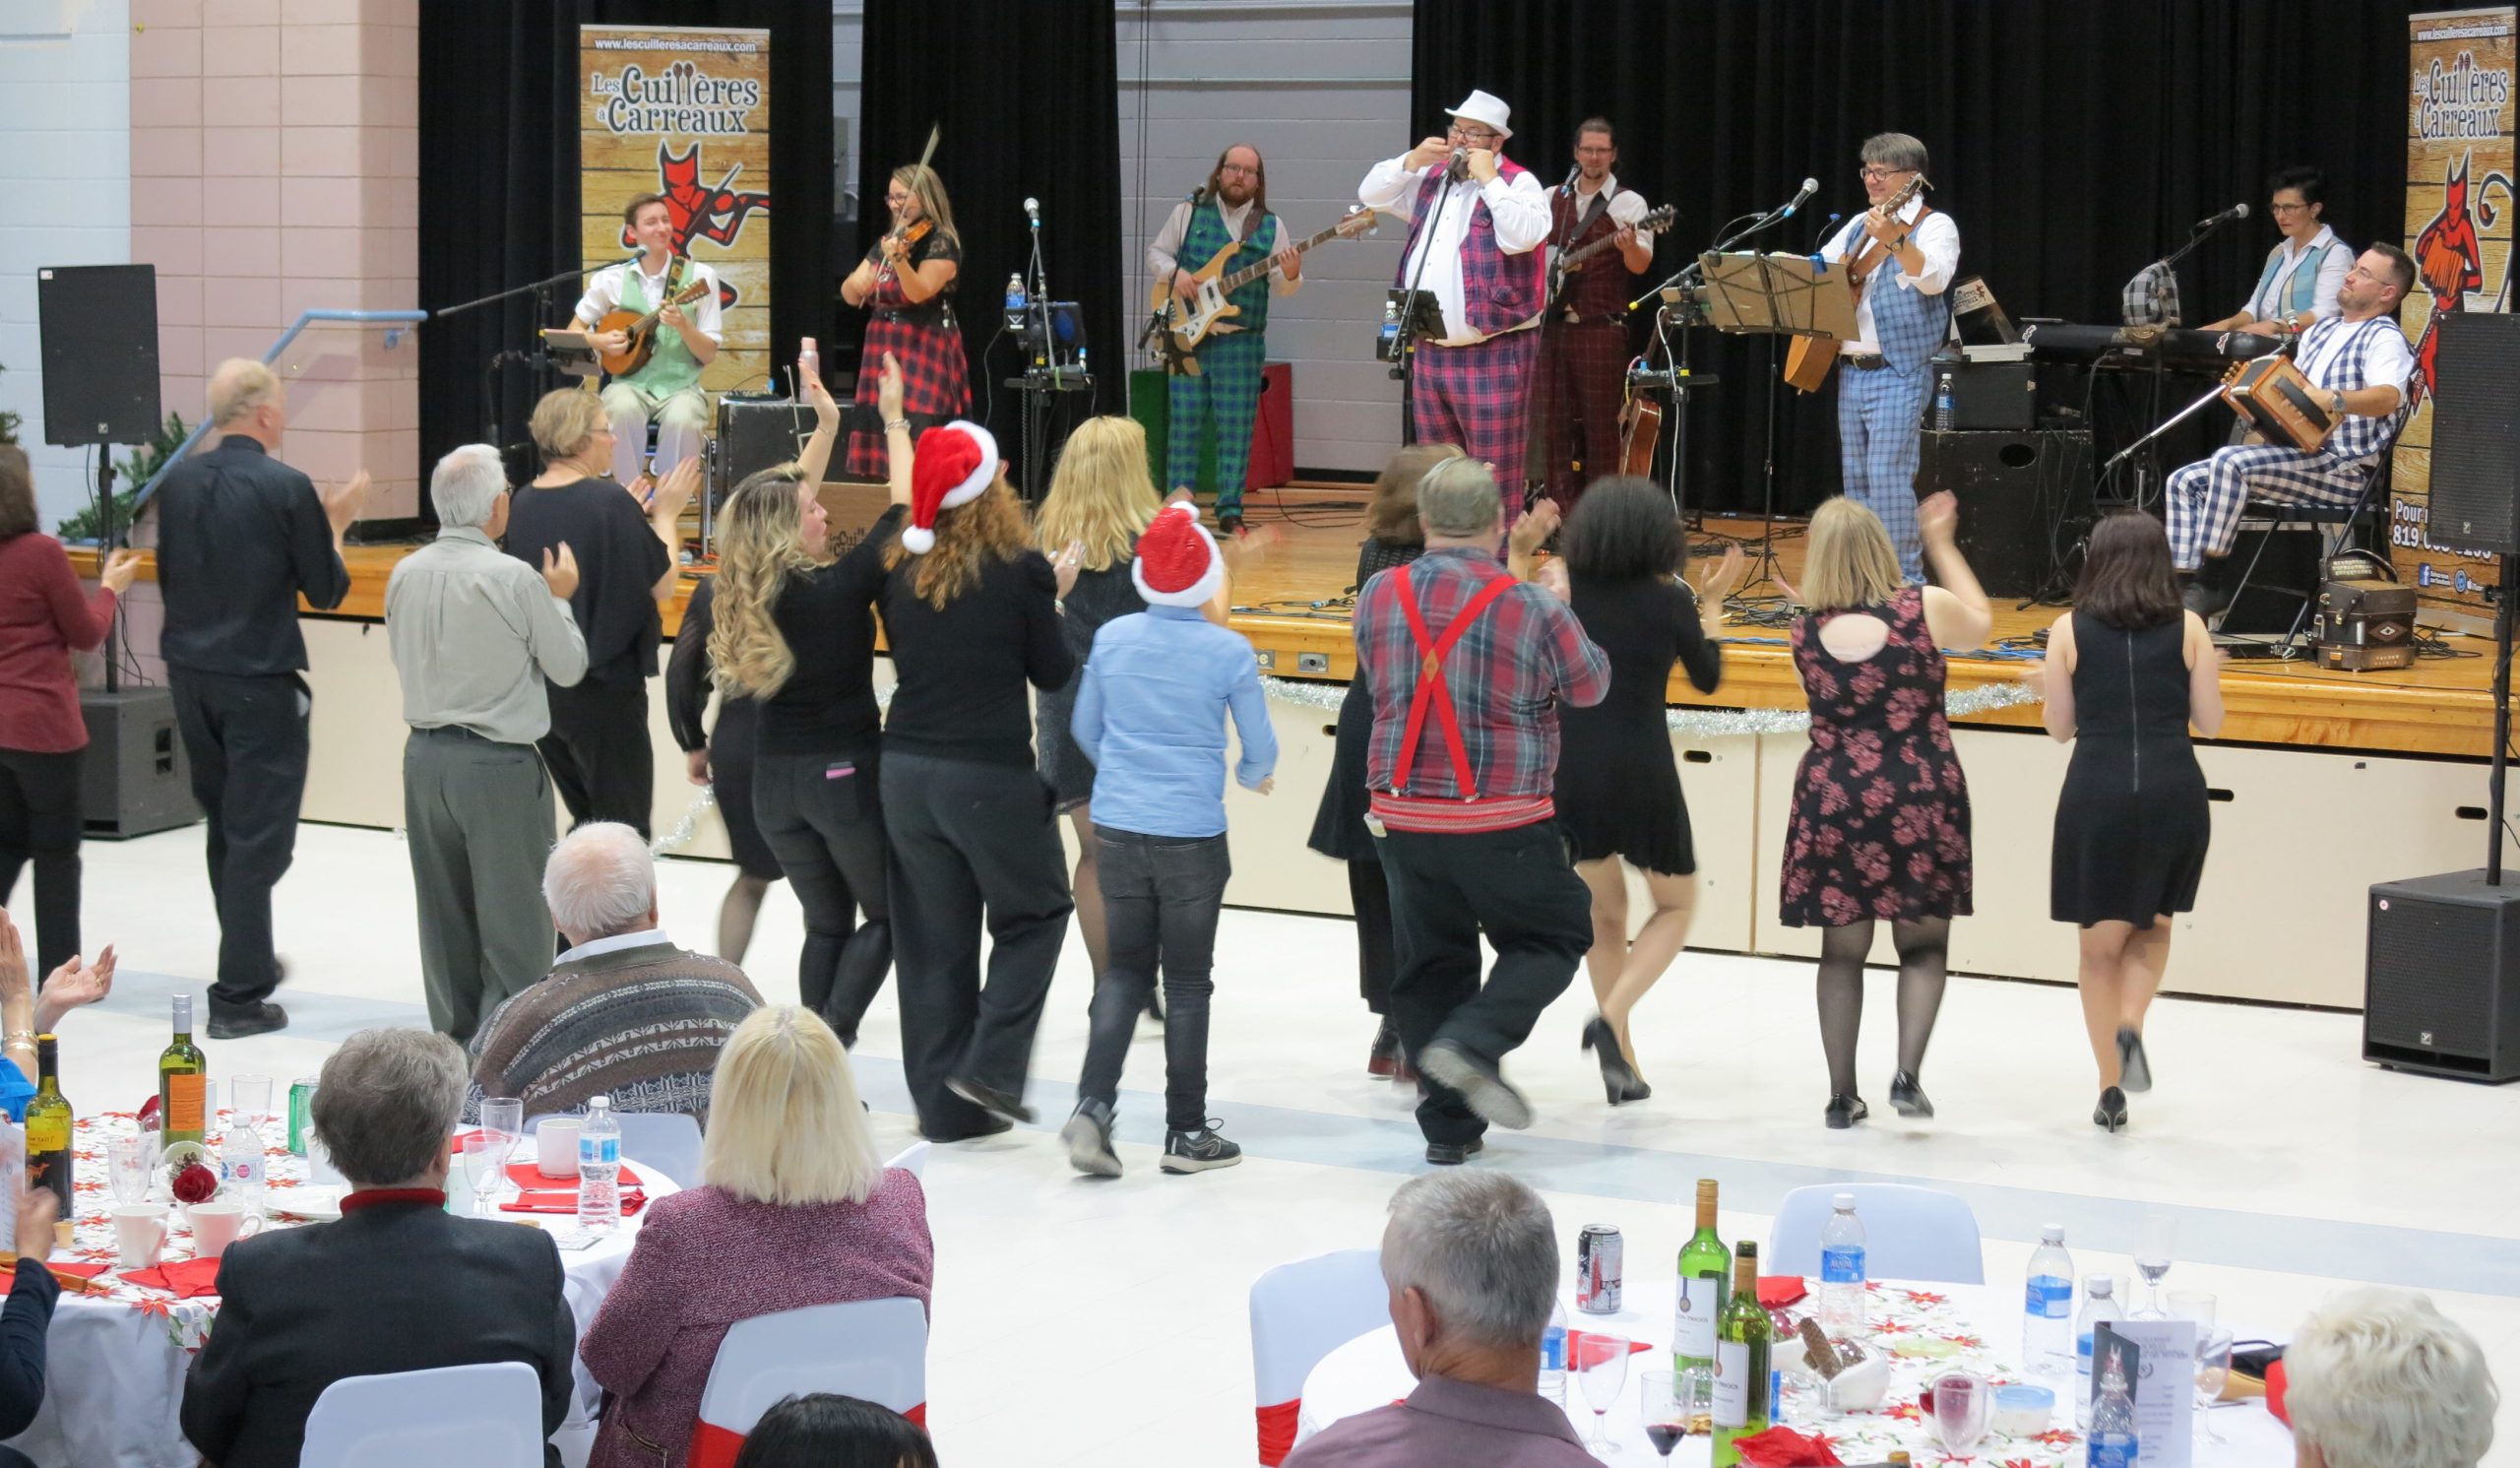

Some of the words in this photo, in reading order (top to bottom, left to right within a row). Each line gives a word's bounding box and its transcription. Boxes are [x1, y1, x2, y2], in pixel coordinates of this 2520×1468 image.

[595, 37, 757, 53] www.lescuilleresacarreaux.com
[594, 75, 619, 94] Les
[621, 62, 758, 106] Cuillères
[2415, 73, 2428, 94] Les
[2428, 53, 2507, 105] Cuillères
[598, 108, 606, 120] à
[607, 98, 746, 133] Carreaux
[2421, 98, 2499, 140] Carreaux
[2395, 499, 2422, 523] Pour
[2393, 524, 2419, 548] 819
